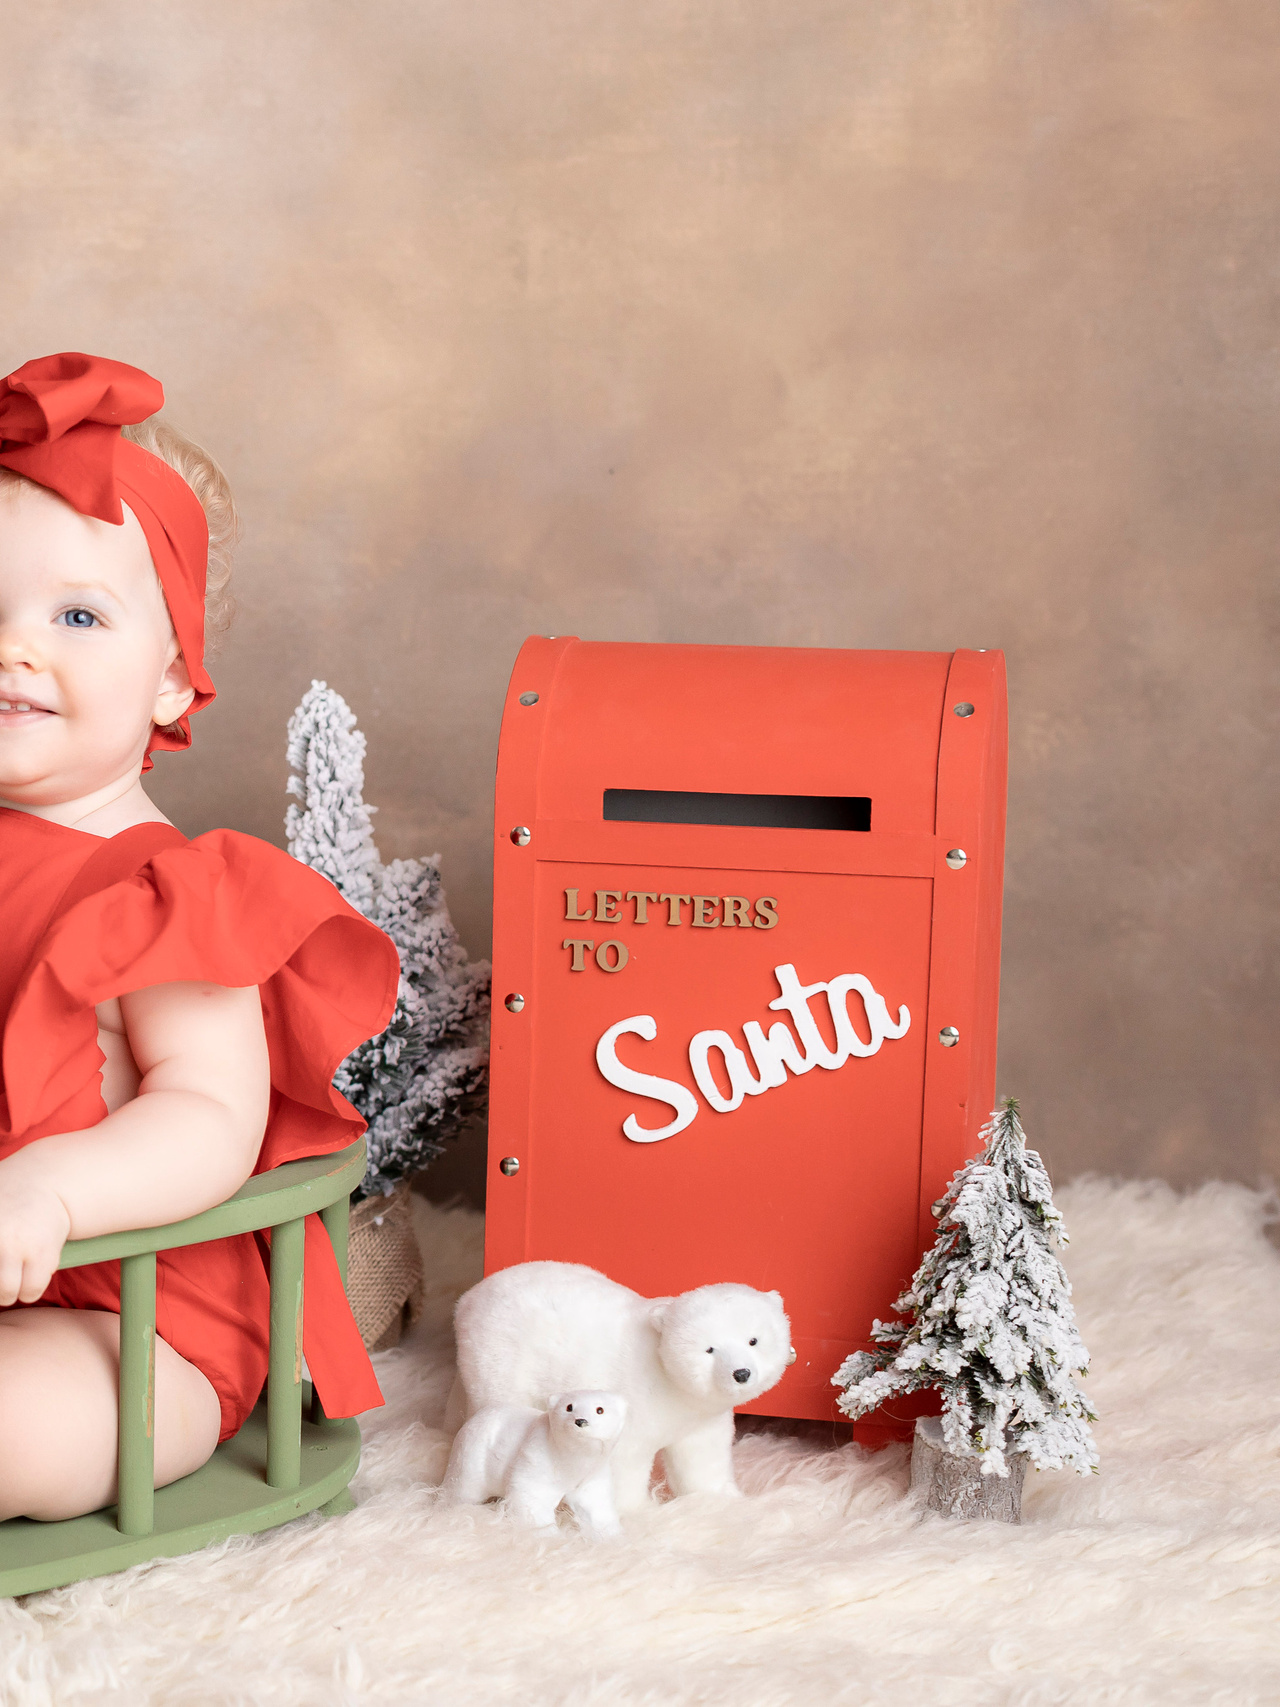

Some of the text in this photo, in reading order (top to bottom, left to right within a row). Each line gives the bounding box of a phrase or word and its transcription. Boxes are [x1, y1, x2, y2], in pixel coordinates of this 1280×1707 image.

[564, 888, 780, 930] LETTERS
[563, 939, 630, 973] TO
[595, 963, 911, 1144] Santa
